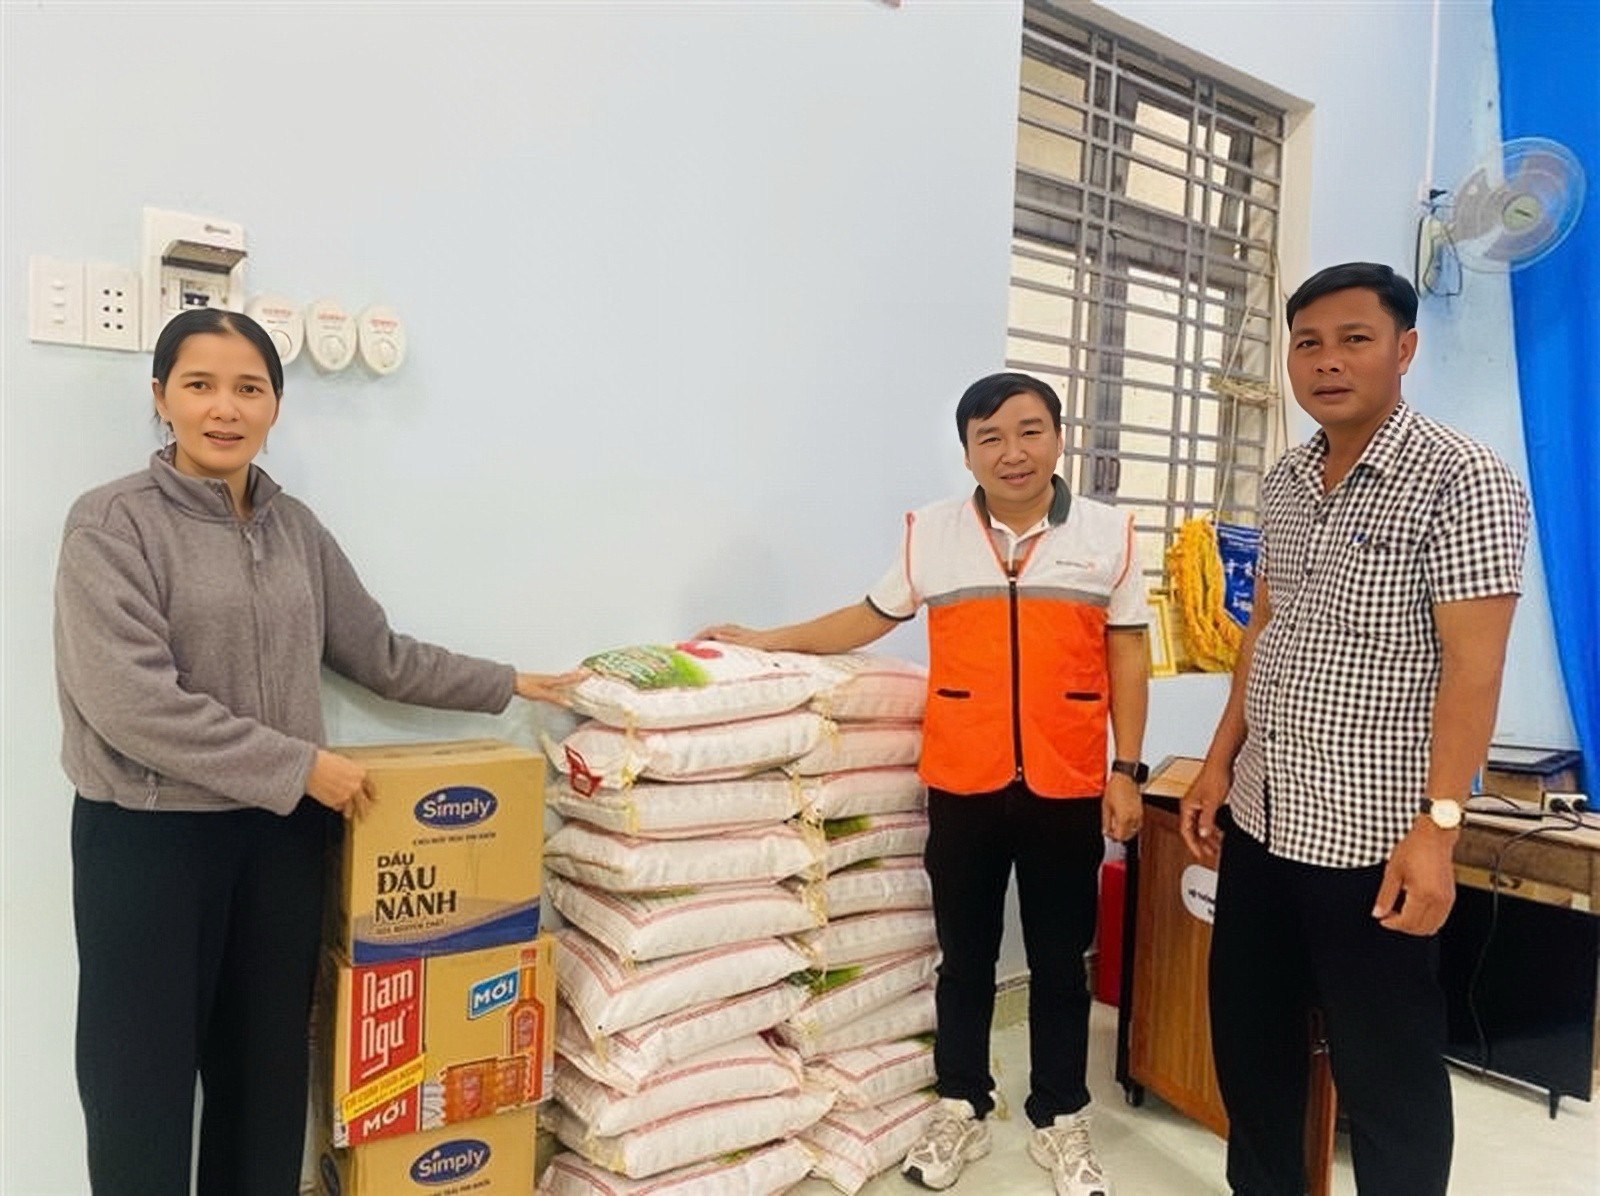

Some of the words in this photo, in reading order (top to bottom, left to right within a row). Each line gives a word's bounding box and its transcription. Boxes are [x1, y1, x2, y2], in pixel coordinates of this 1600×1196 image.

[422, 793, 491, 820] Simply
[361, 968, 414, 1016] Nam
[474, 977, 514, 1006] MỚI
[362, 1098, 408, 1137] MỚI
[418, 1148, 485, 1177] Simply
